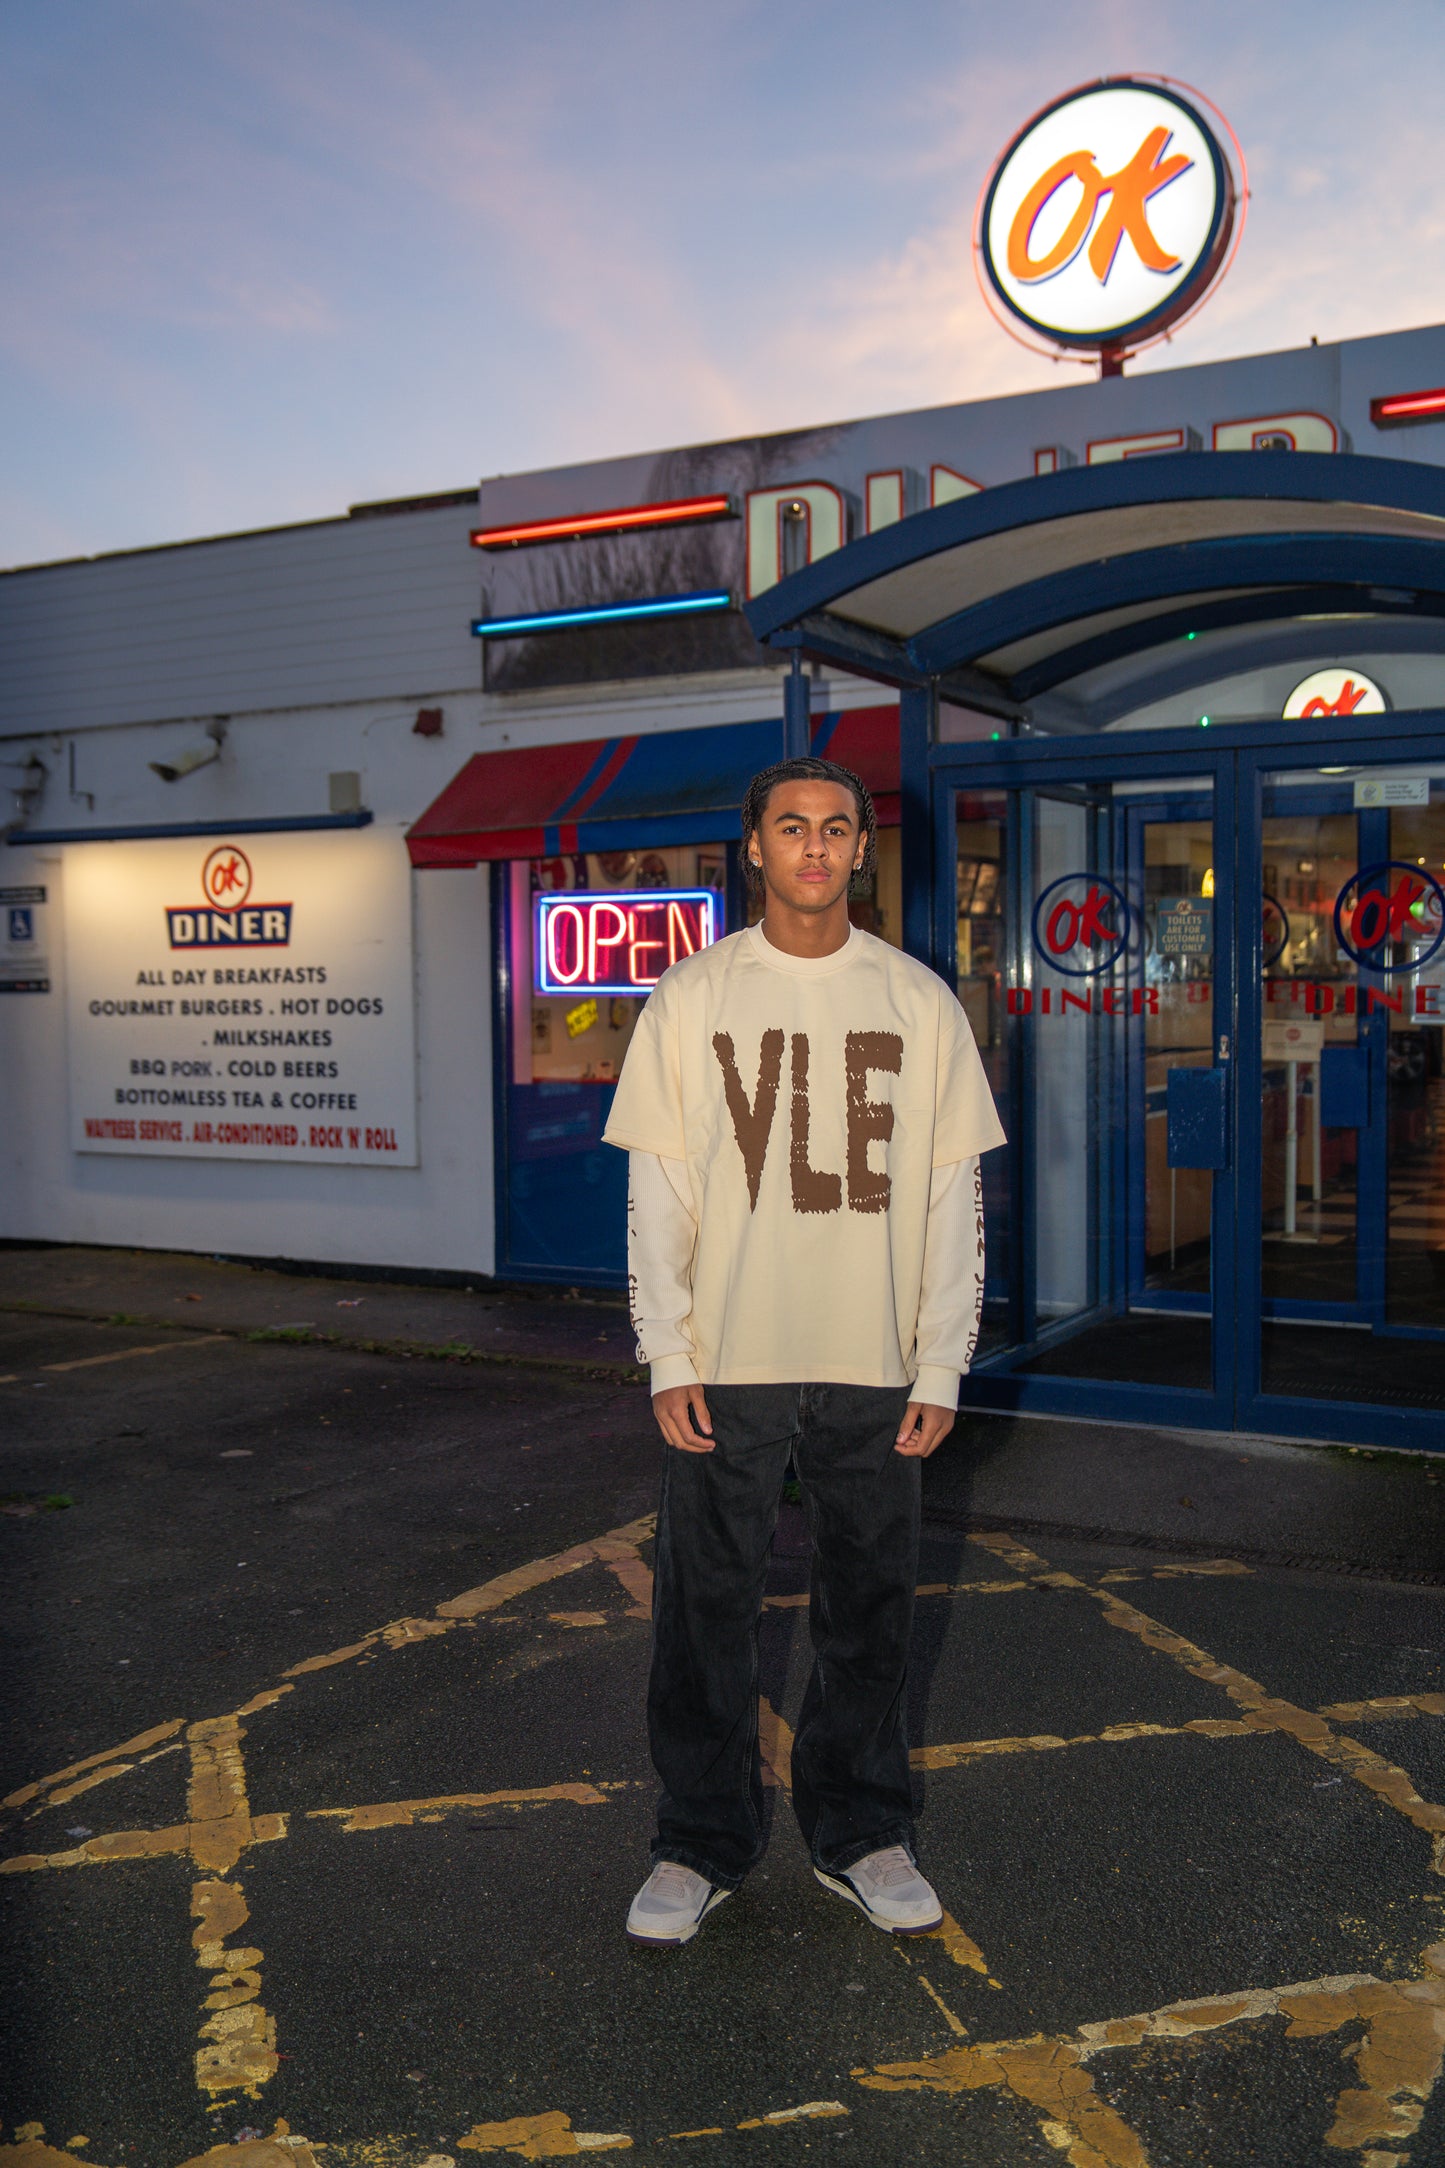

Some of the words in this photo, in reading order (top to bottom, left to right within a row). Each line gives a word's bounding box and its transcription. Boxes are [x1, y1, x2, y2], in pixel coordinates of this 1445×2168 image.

[1007, 125, 1195, 287] OK
[210, 856, 244, 898] OK
[1046, 885, 1119, 955] OK
[1167, 915, 1202, 925] TOILETS
[1350, 875, 1435, 949] OK
[171, 912, 287, 944] DINER
[1162, 934, 1206, 944] CUSTOMER
[1167, 925, 1182, 934] ARE
[1184, 925, 1201, 934] FOR
[548, 901, 708, 985] OPEN
[1165, 943, 1179, 952] USE
[1182, 943, 1203, 952] ONLY
[136, 970, 166, 986] ALL
[171, 969, 206, 985] DAY
[212, 967, 328, 985] BREAKFASTS
[89, 1000, 174, 1017] GOURMET
[180, 999, 263, 1016] BURGERS
[281, 998, 320, 1016] HOT
[326, 998, 384, 1016] DOGS
[1006, 987, 1160, 1015] DINER
[1304, 984, 1441, 1015] DINE
[212, 1029, 333, 1047] MILKSHAKES
[129, 1058, 166, 1076] BBQ
[170, 1060, 213, 1077] PORK
[227, 1060, 277, 1077] COLD
[283, 1060, 339, 1079] BEERS
[114, 1087, 227, 1107] BOTTOMLESS
[232, 1090, 265, 1108] TEA
[270, 1091, 284, 1108] &
[290, 1092, 358, 1111] COFFEE
[83, 1118, 136, 1141] WAITRESS
[139, 1119, 184, 1143] SERVICE
[192, 1121, 298, 1146] AIR-CONDITIONED
[309, 1125, 344, 1149] ROCK
[365, 1127, 398, 1152] ROLL
[711, 1028, 904, 1216] VLE
